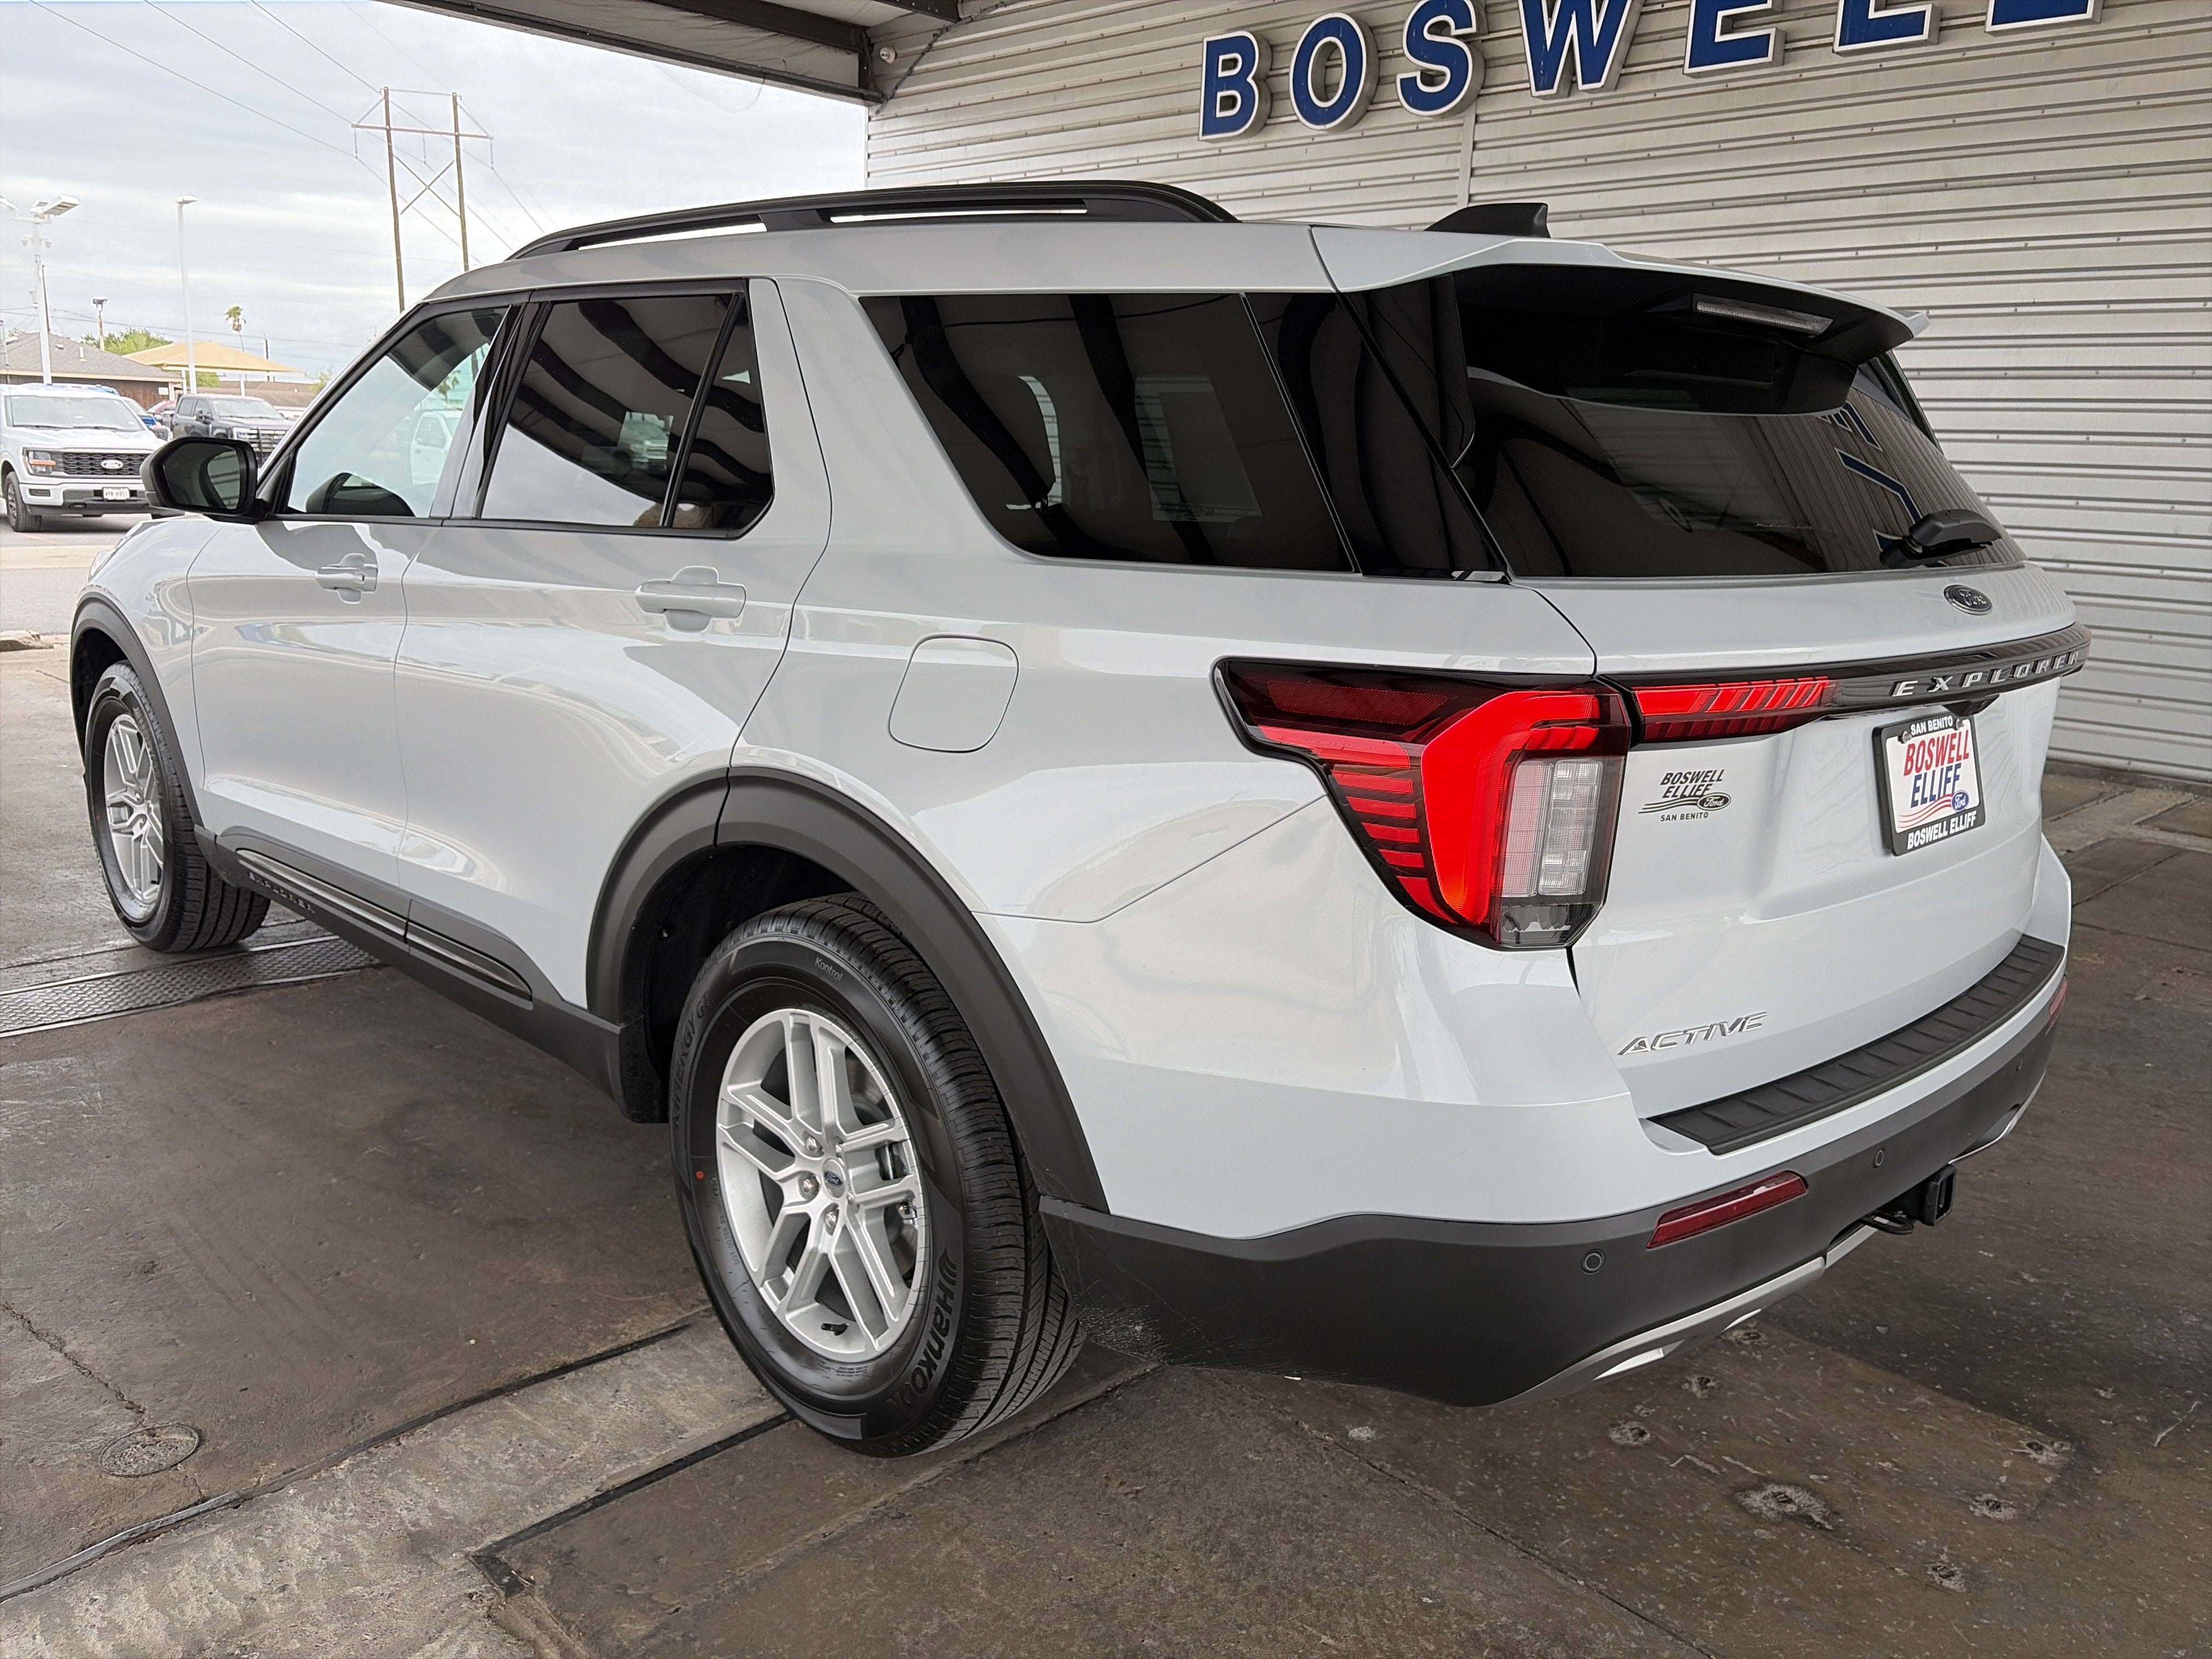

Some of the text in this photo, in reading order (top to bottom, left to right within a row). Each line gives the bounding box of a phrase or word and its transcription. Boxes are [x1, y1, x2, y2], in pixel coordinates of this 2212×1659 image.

[1890, 651, 2079, 697] EXPLORER
[1911, 715, 1953, 736] SAN BENITO
[1904, 730, 1970, 776] BOSWELL
[1660, 769, 1725, 785] BOSWELL
[1910, 763, 1962, 808] ELLIFF
[1662, 783, 1713, 798] ELLIFF
[1703, 795, 1724, 808] Ford
[1954, 793, 1967, 810] Ford
[1680, 812, 1708, 821] BENITO
[1907, 810, 1977, 850] BOSWELL ELLIFF
[815, 957, 843, 981] Kontrol
[1617, 1011, 1768, 1056] ACTIVE
